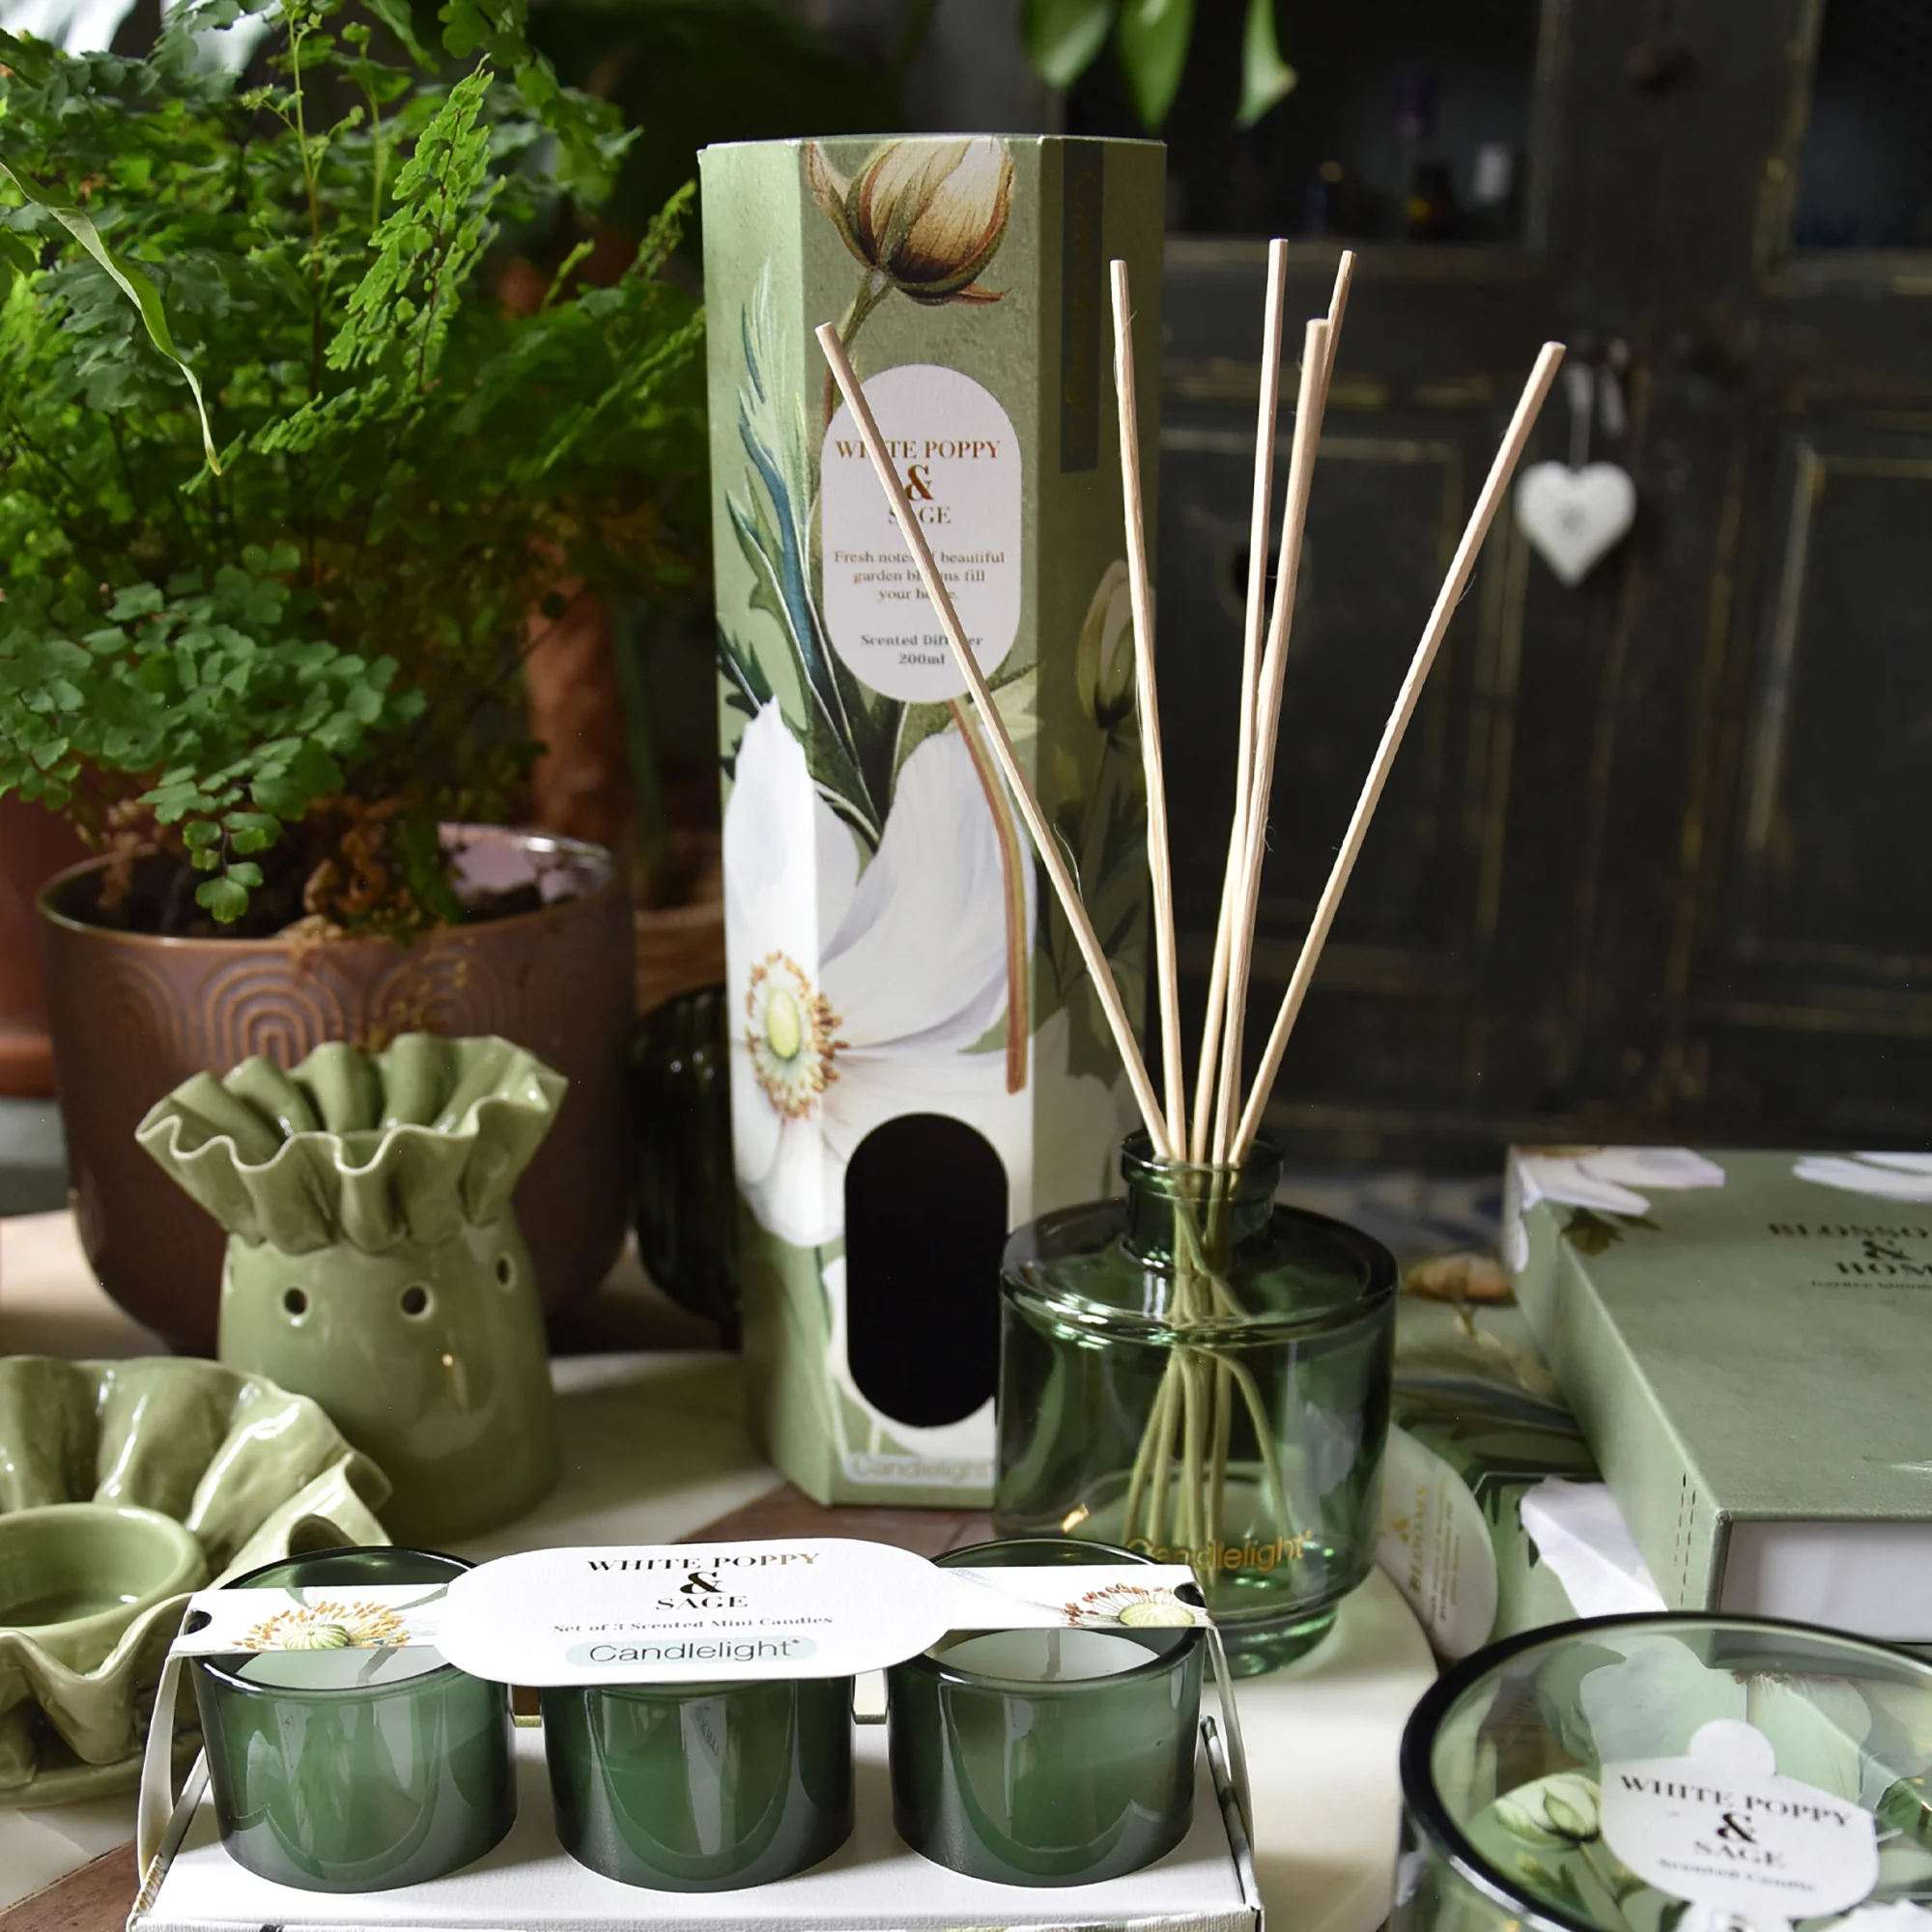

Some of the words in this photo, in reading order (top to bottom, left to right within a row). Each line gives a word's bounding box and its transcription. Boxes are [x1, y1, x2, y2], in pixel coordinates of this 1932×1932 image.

[835, 440, 917, 459] WTE
[923, 440, 1001, 459] POPPY
[904, 464, 935, 501] &
[888, 505, 952, 525] SGE
[834, 551, 874, 563] Fresh
[940, 551, 1005, 563] beautiful
[853, 569, 902, 584] garden
[906, 569, 960, 582] blms
[965, 569, 985, 582] fill
[878, 590, 911, 603] your
[860, 634, 917, 646] Scented
[923, 634, 983, 646] Differ
[898, 653, 946, 666] 200ml
[587, 1557, 701, 1572] WHITE
[713, 1552, 819, 1569] POPPY
[679, 1571, 725, 1595] &
[655, 1595, 748, 1610] SAGE
[553, 1624, 582, 1633] Set
[589, 1623, 609, 1632] of
[630, 1621, 704, 1631] Scented
[711, 1618, 753, 1628] Mini
[759, 1615, 834, 1627] Candles
[589, 1638, 801, 1662] Candlelight
[1620, 1774, 1734, 1808] WHITE
[1744, 1794, 1852, 1829] POPPY
[1716, 1811, 1758, 1845] &
[1693, 1839, 1786, 1870] SAGE
